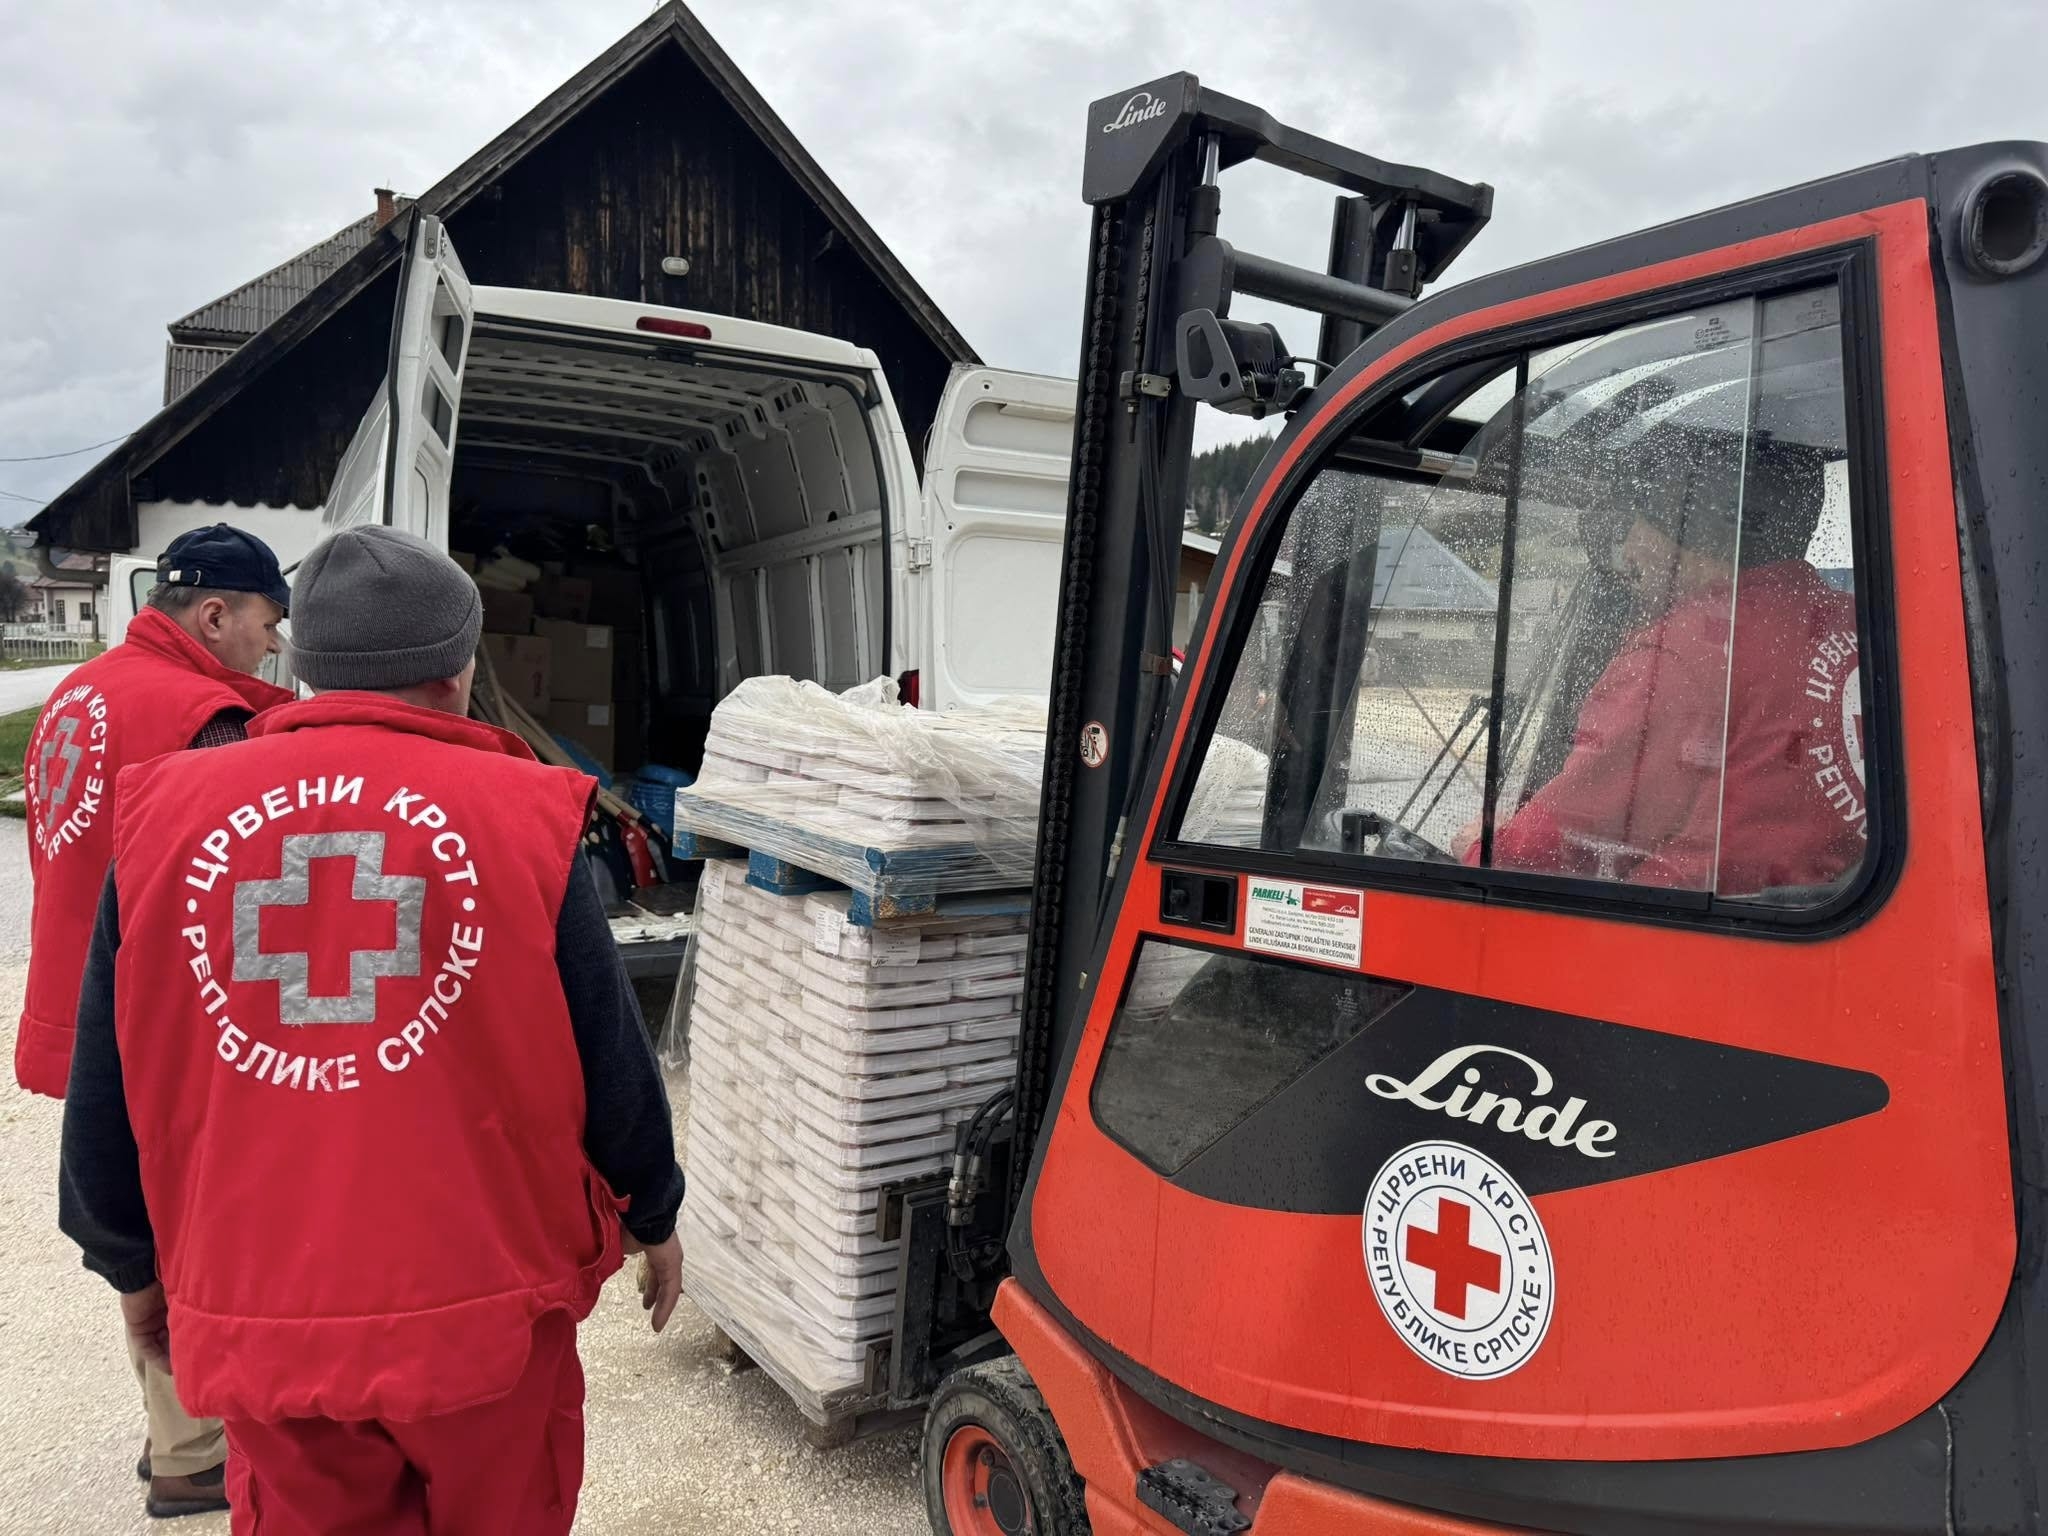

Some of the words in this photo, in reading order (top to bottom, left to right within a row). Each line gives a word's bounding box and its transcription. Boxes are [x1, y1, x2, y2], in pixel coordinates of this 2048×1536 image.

[1103, 92, 1166, 133] Linde
[1805, 631, 1860, 703] ЦРВЕН
[86, 693, 107, 755] КРСТ
[47, 775, 104, 862] СРПСКЕ
[185, 774, 365, 893] ЦРВЕНИ
[383, 787, 480, 888] КРСТ
[181, 923, 361, 1093] РЕПБЛИКЕ
[376, 922, 484, 1073] СРПСКЕ
[1364, 1043, 1618, 1158] Linde
[1377, 1154, 1465, 1214] ЦРВЕНИ
[1478, 1173, 1539, 1256] КРСТ
[1372, 1226, 1469, 1364] РЕПУБЛИКЕ
[1473, 1279, 1541, 1365] СРПСКЕ
